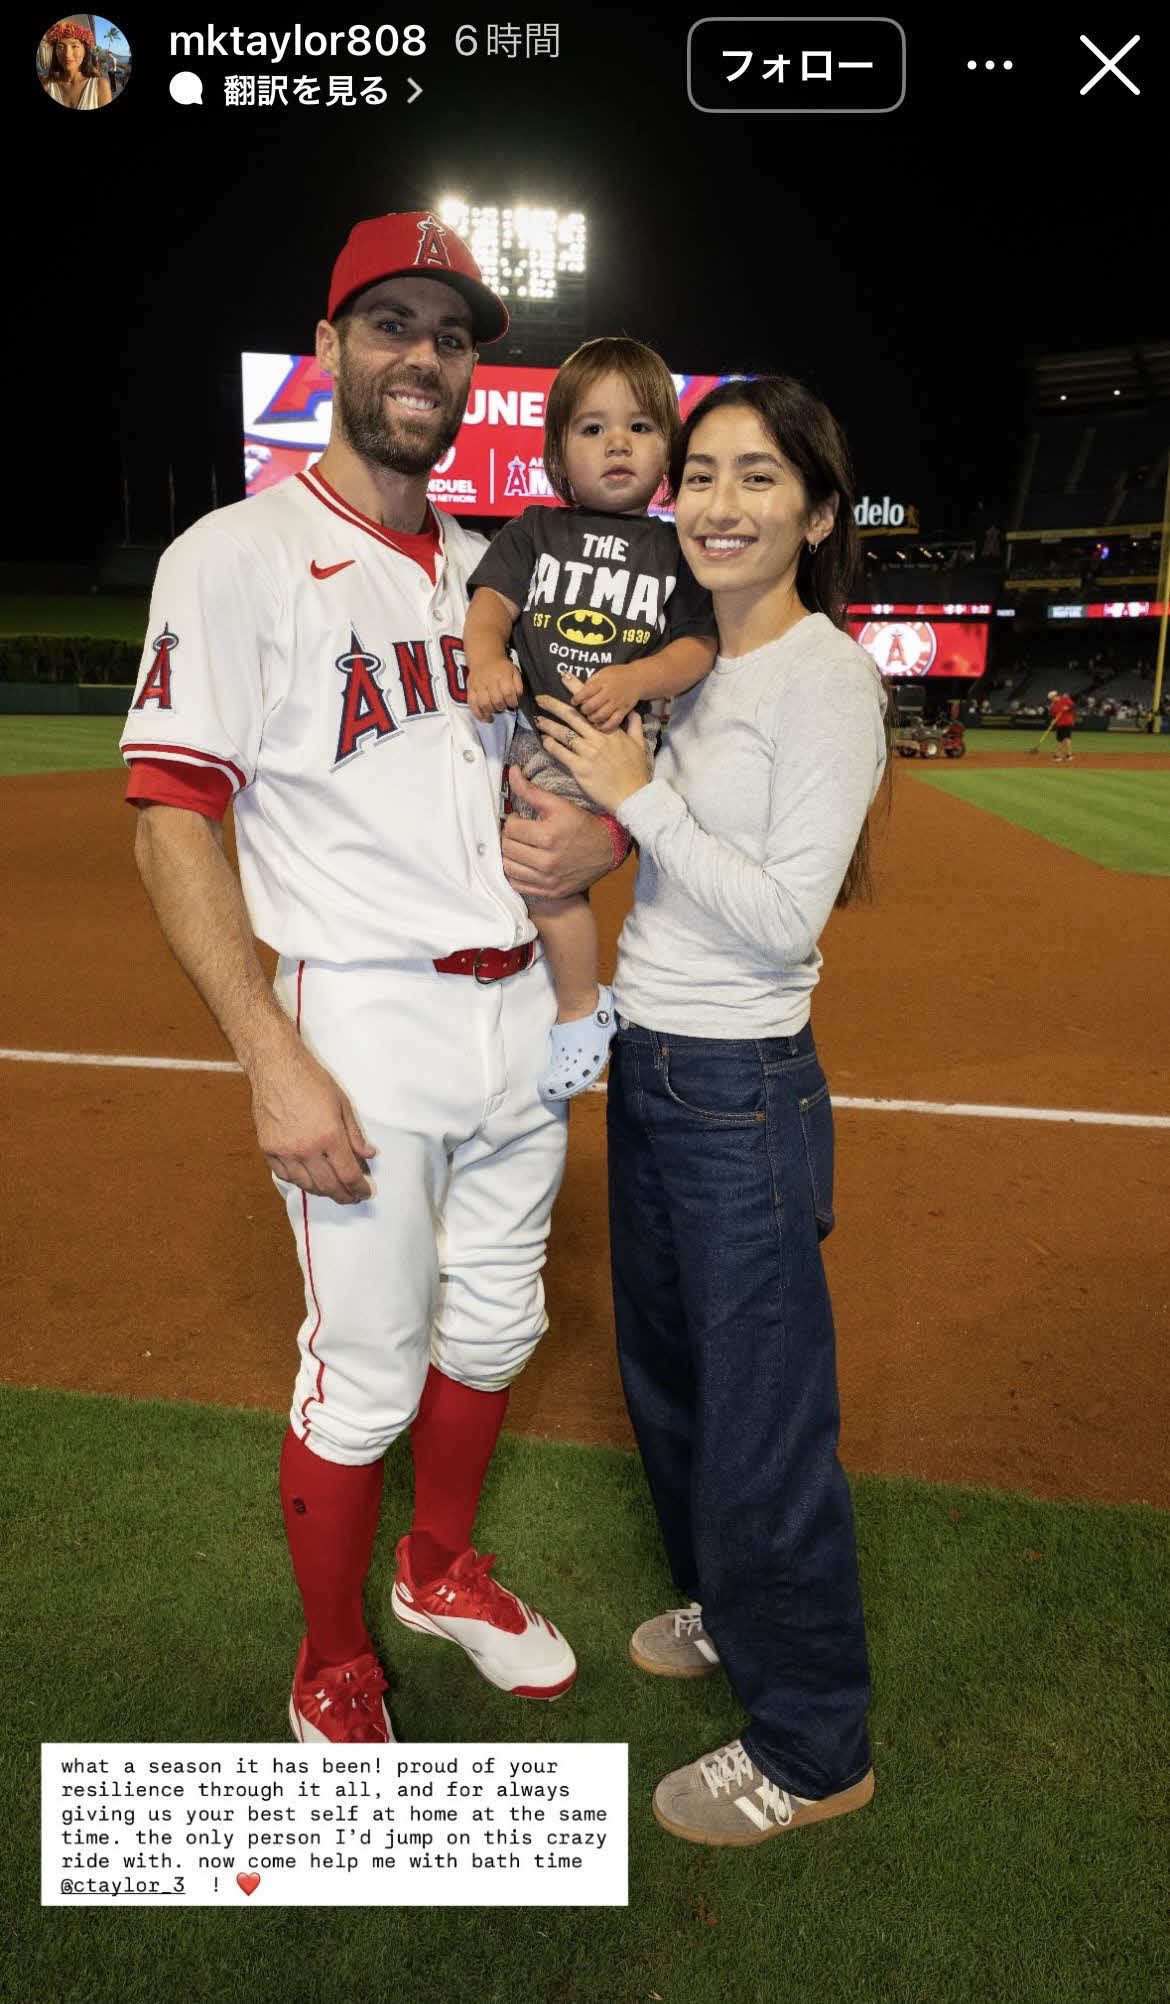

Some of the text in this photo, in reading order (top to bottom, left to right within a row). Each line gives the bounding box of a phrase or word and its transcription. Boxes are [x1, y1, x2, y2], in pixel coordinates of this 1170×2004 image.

[854, 496, 905, 526] delo
[582, 533, 629, 562] THE
[523, 553, 677, 634] ATMA
[549, 642, 612, 664] GOTHAM
